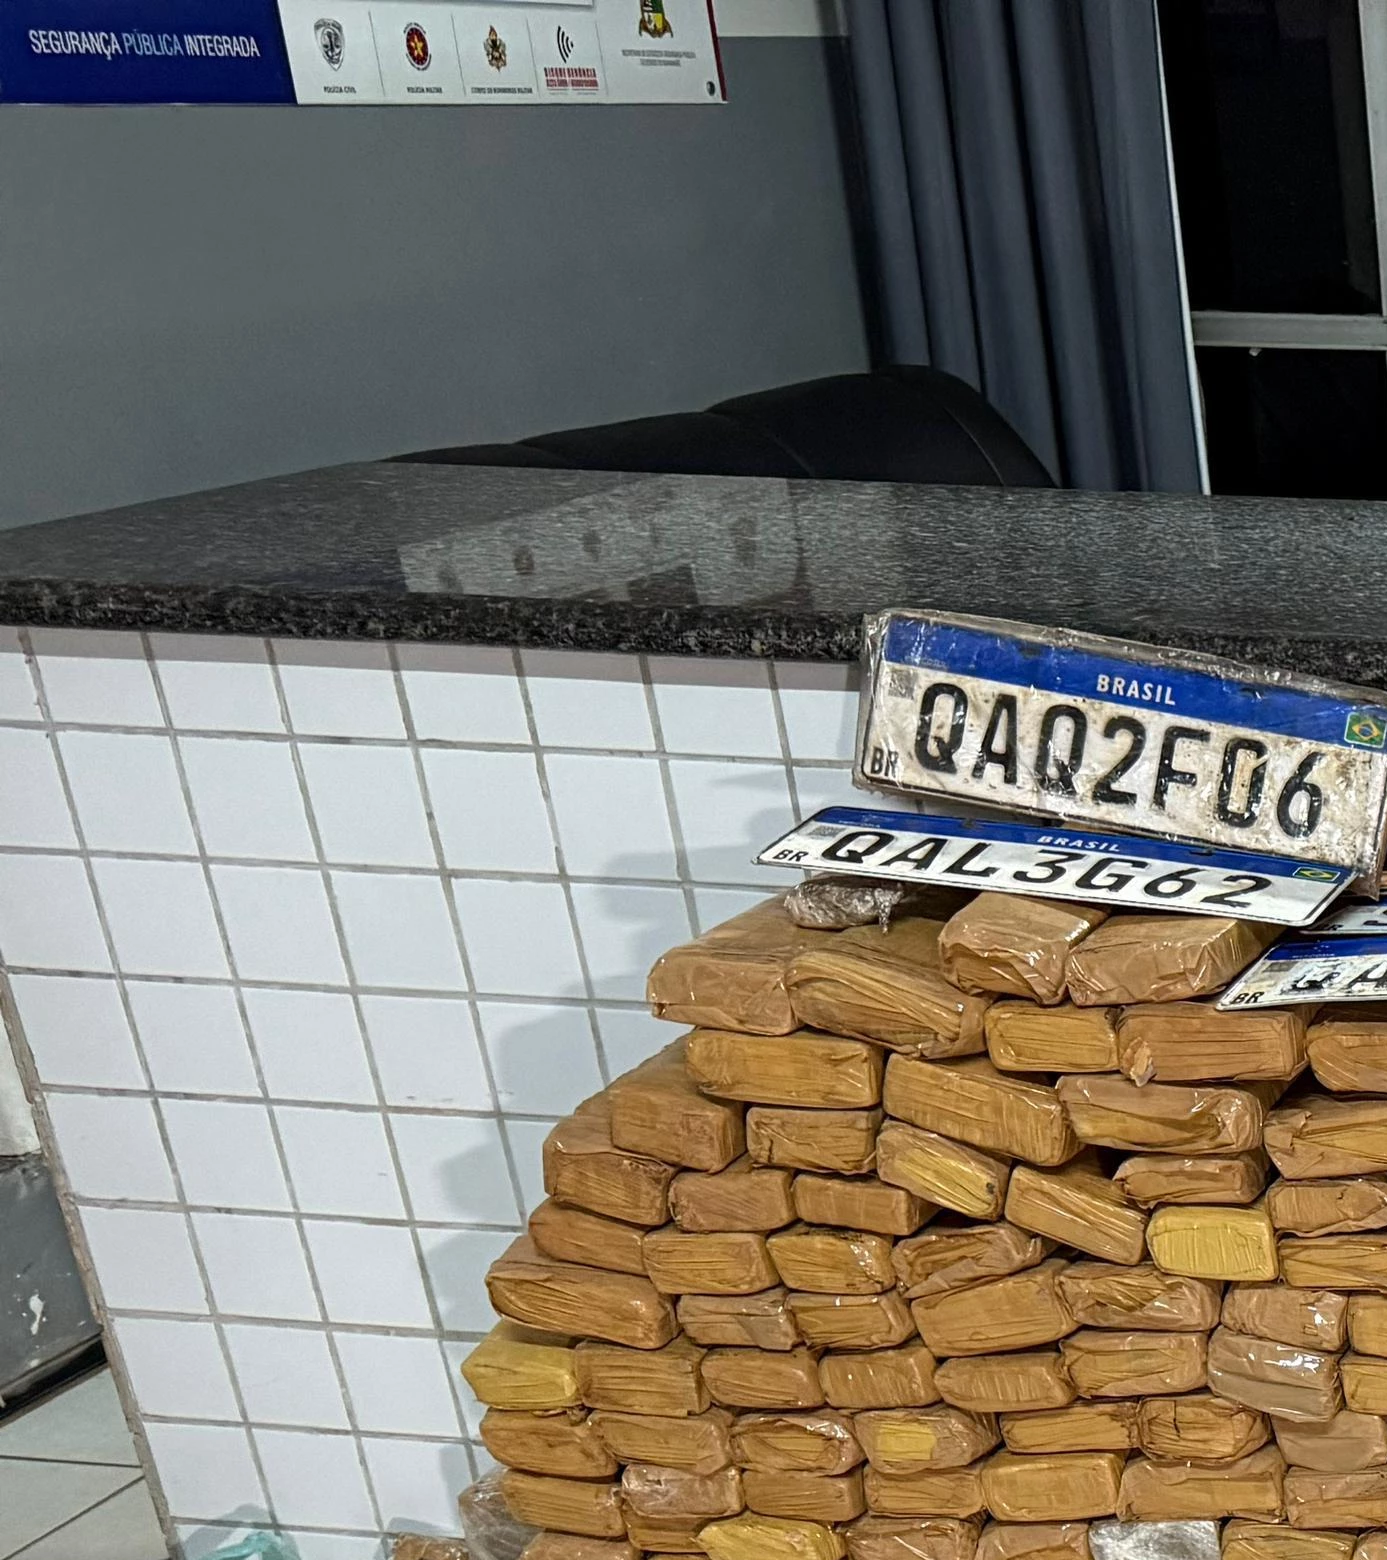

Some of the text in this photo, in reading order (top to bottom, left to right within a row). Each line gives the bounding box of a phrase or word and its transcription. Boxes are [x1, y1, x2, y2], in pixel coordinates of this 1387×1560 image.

[29, 28, 260, 60] SEGURANÇA PÚBLICA INTEGRADA
[1096, 674, 1176, 705] BRASIL
[870, 746, 899, 778] BR
[914, 682, 1327, 838] QAQ2F06
[772, 849, 809, 862] BR
[1037, 835, 1121, 852] BRASIL
[821, 831, 1274, 909] QAL3G62
[1231, 991, 1265, 1005] BR
